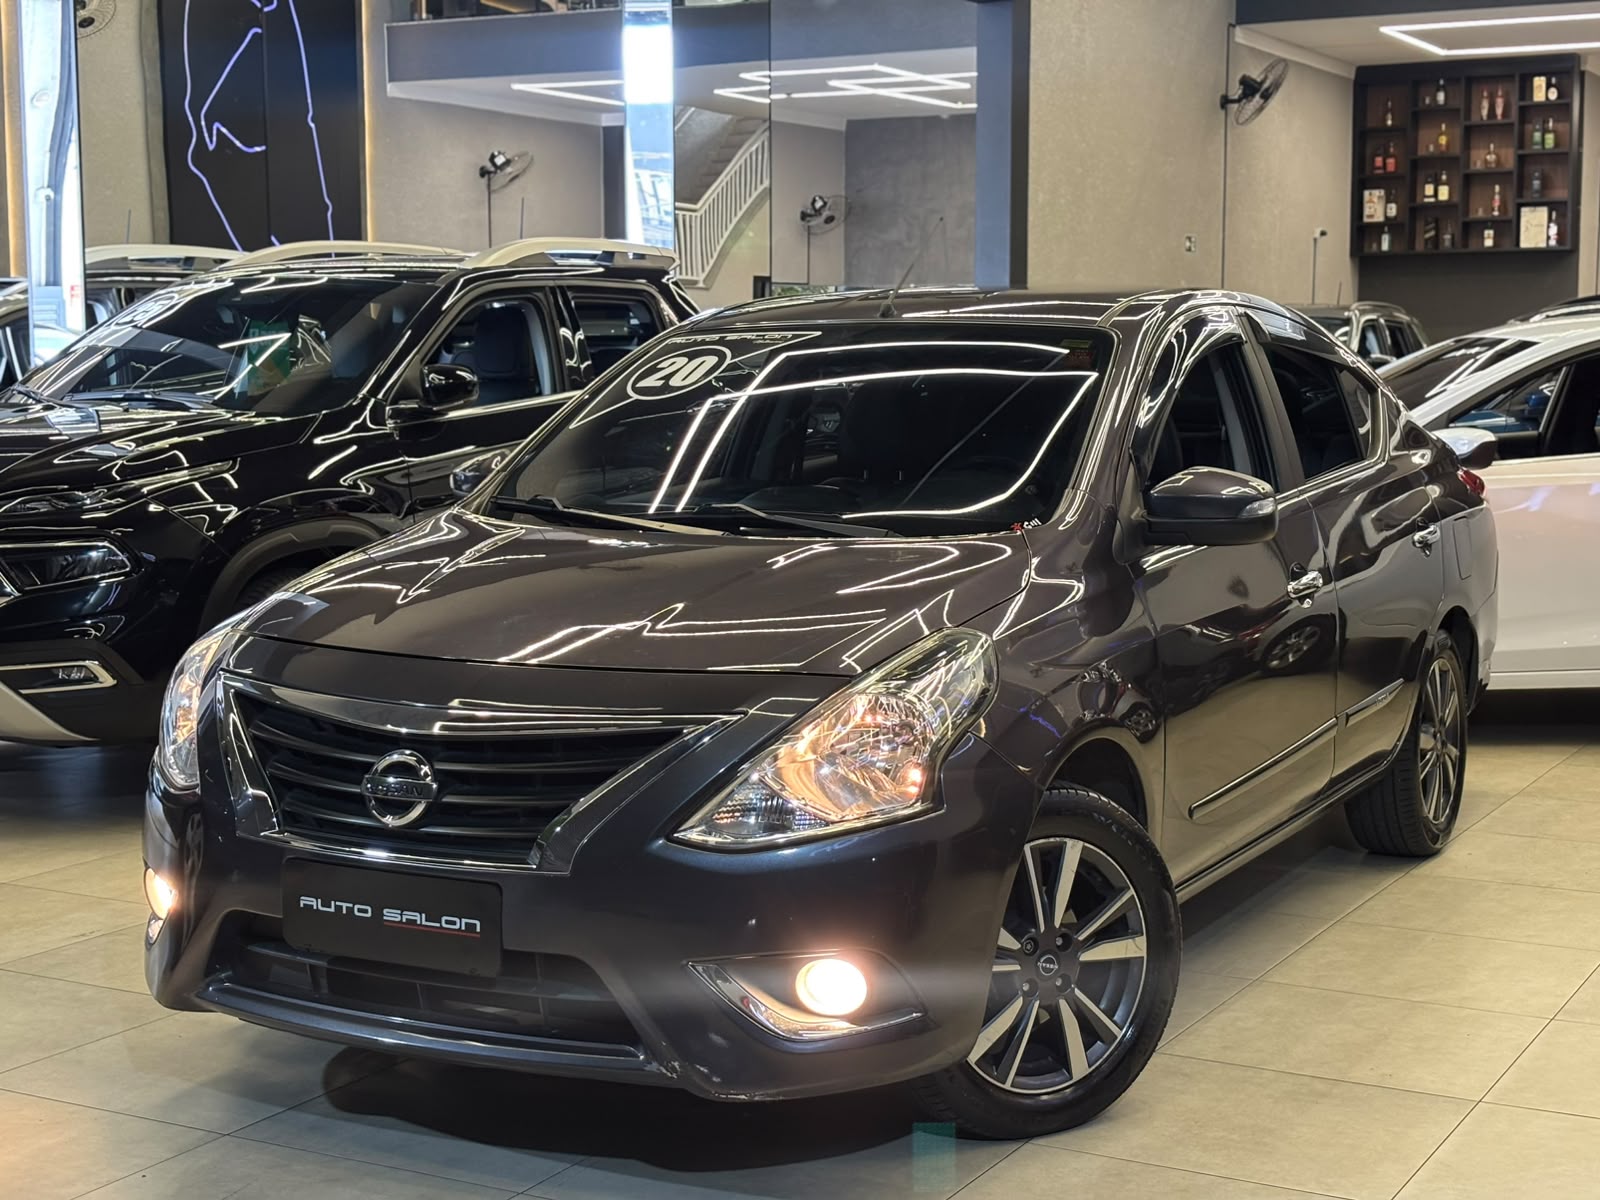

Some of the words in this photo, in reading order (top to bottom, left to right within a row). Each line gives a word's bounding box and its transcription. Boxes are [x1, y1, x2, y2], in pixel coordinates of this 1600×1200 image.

[668, 335, 720, 345] AUTO
[724, 333, 793, 341] SALON
[635, 355, 719, 388] 20
[300, 896, 372, 918] AUTO
[383, 908, 481, 933] SALON
